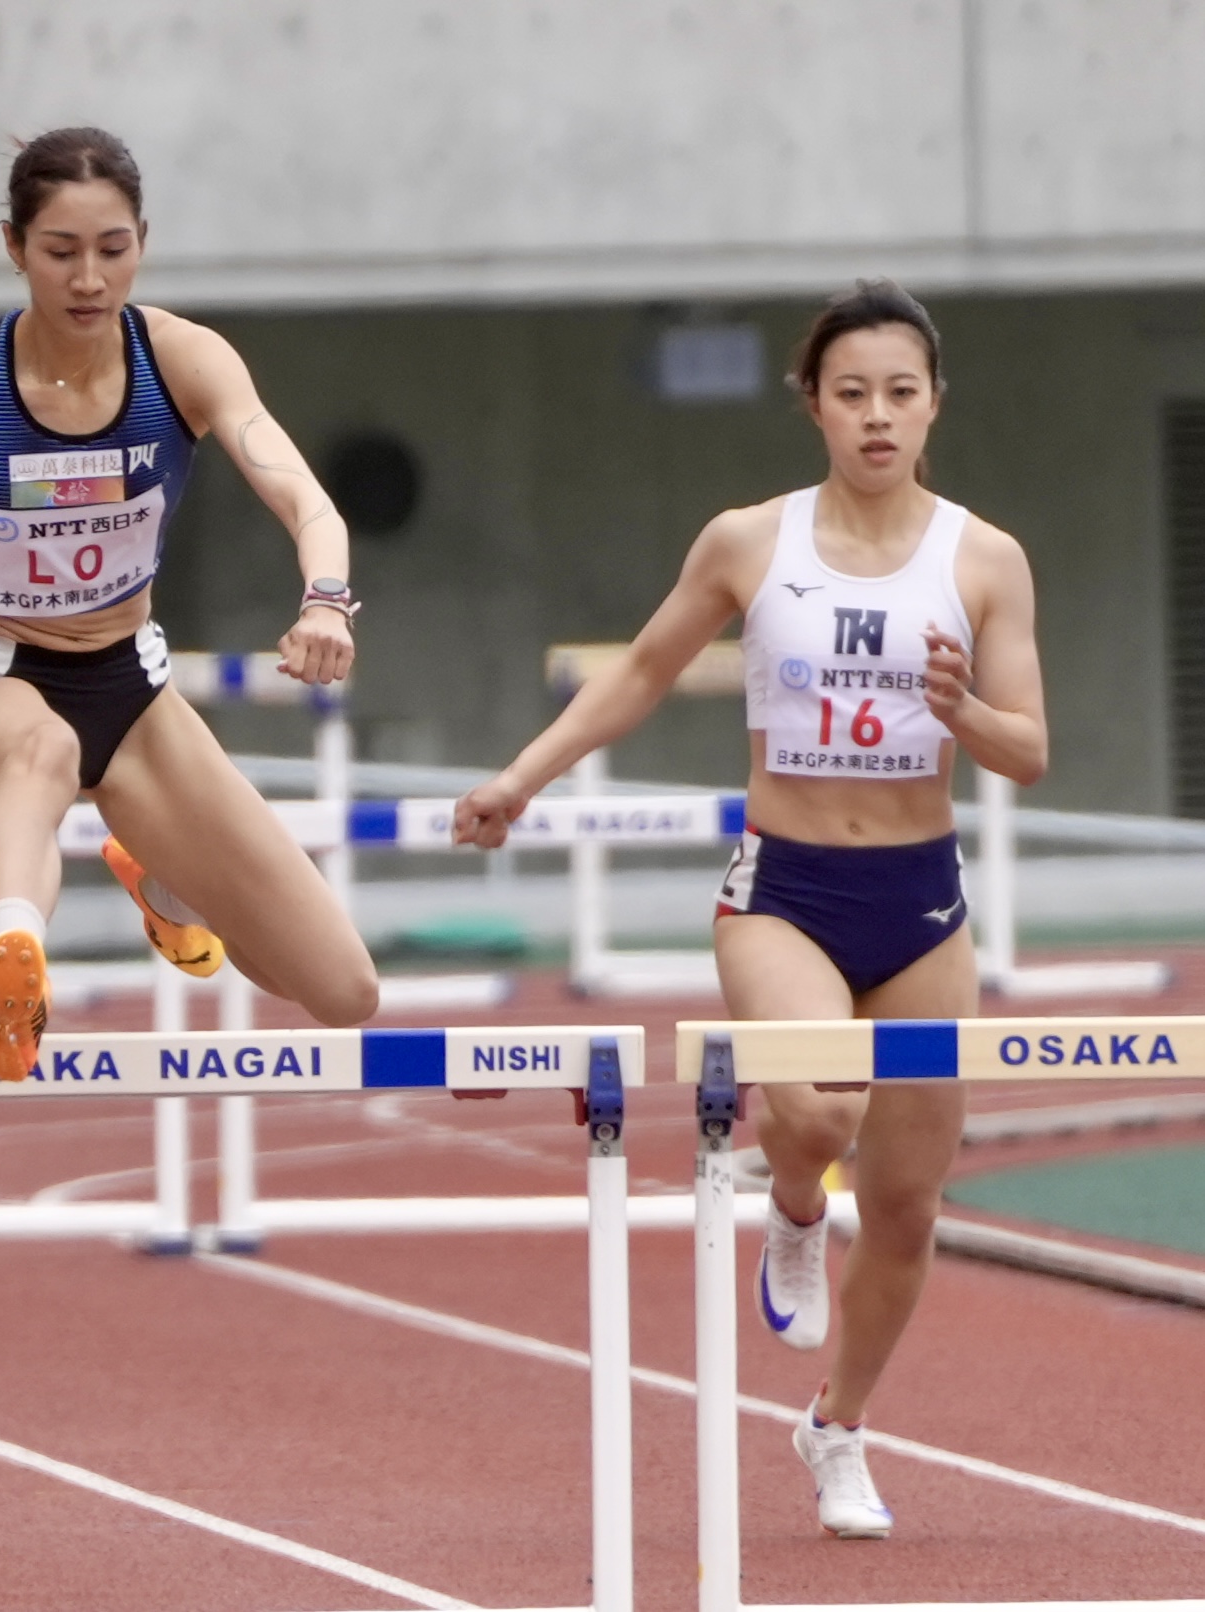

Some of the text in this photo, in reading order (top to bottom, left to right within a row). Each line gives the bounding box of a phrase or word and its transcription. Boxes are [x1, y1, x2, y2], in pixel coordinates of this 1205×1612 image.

[41, 453, 122, 477] 萬泰科技
[27, 544, 103, 585] LO
[818, 696, 884, 748] 16
[159, 1046, 322, 1080] NAGAI
[473, 1045, 561, 1072] NISHI
[999, 1034, 1178, 1066] OSAKA
